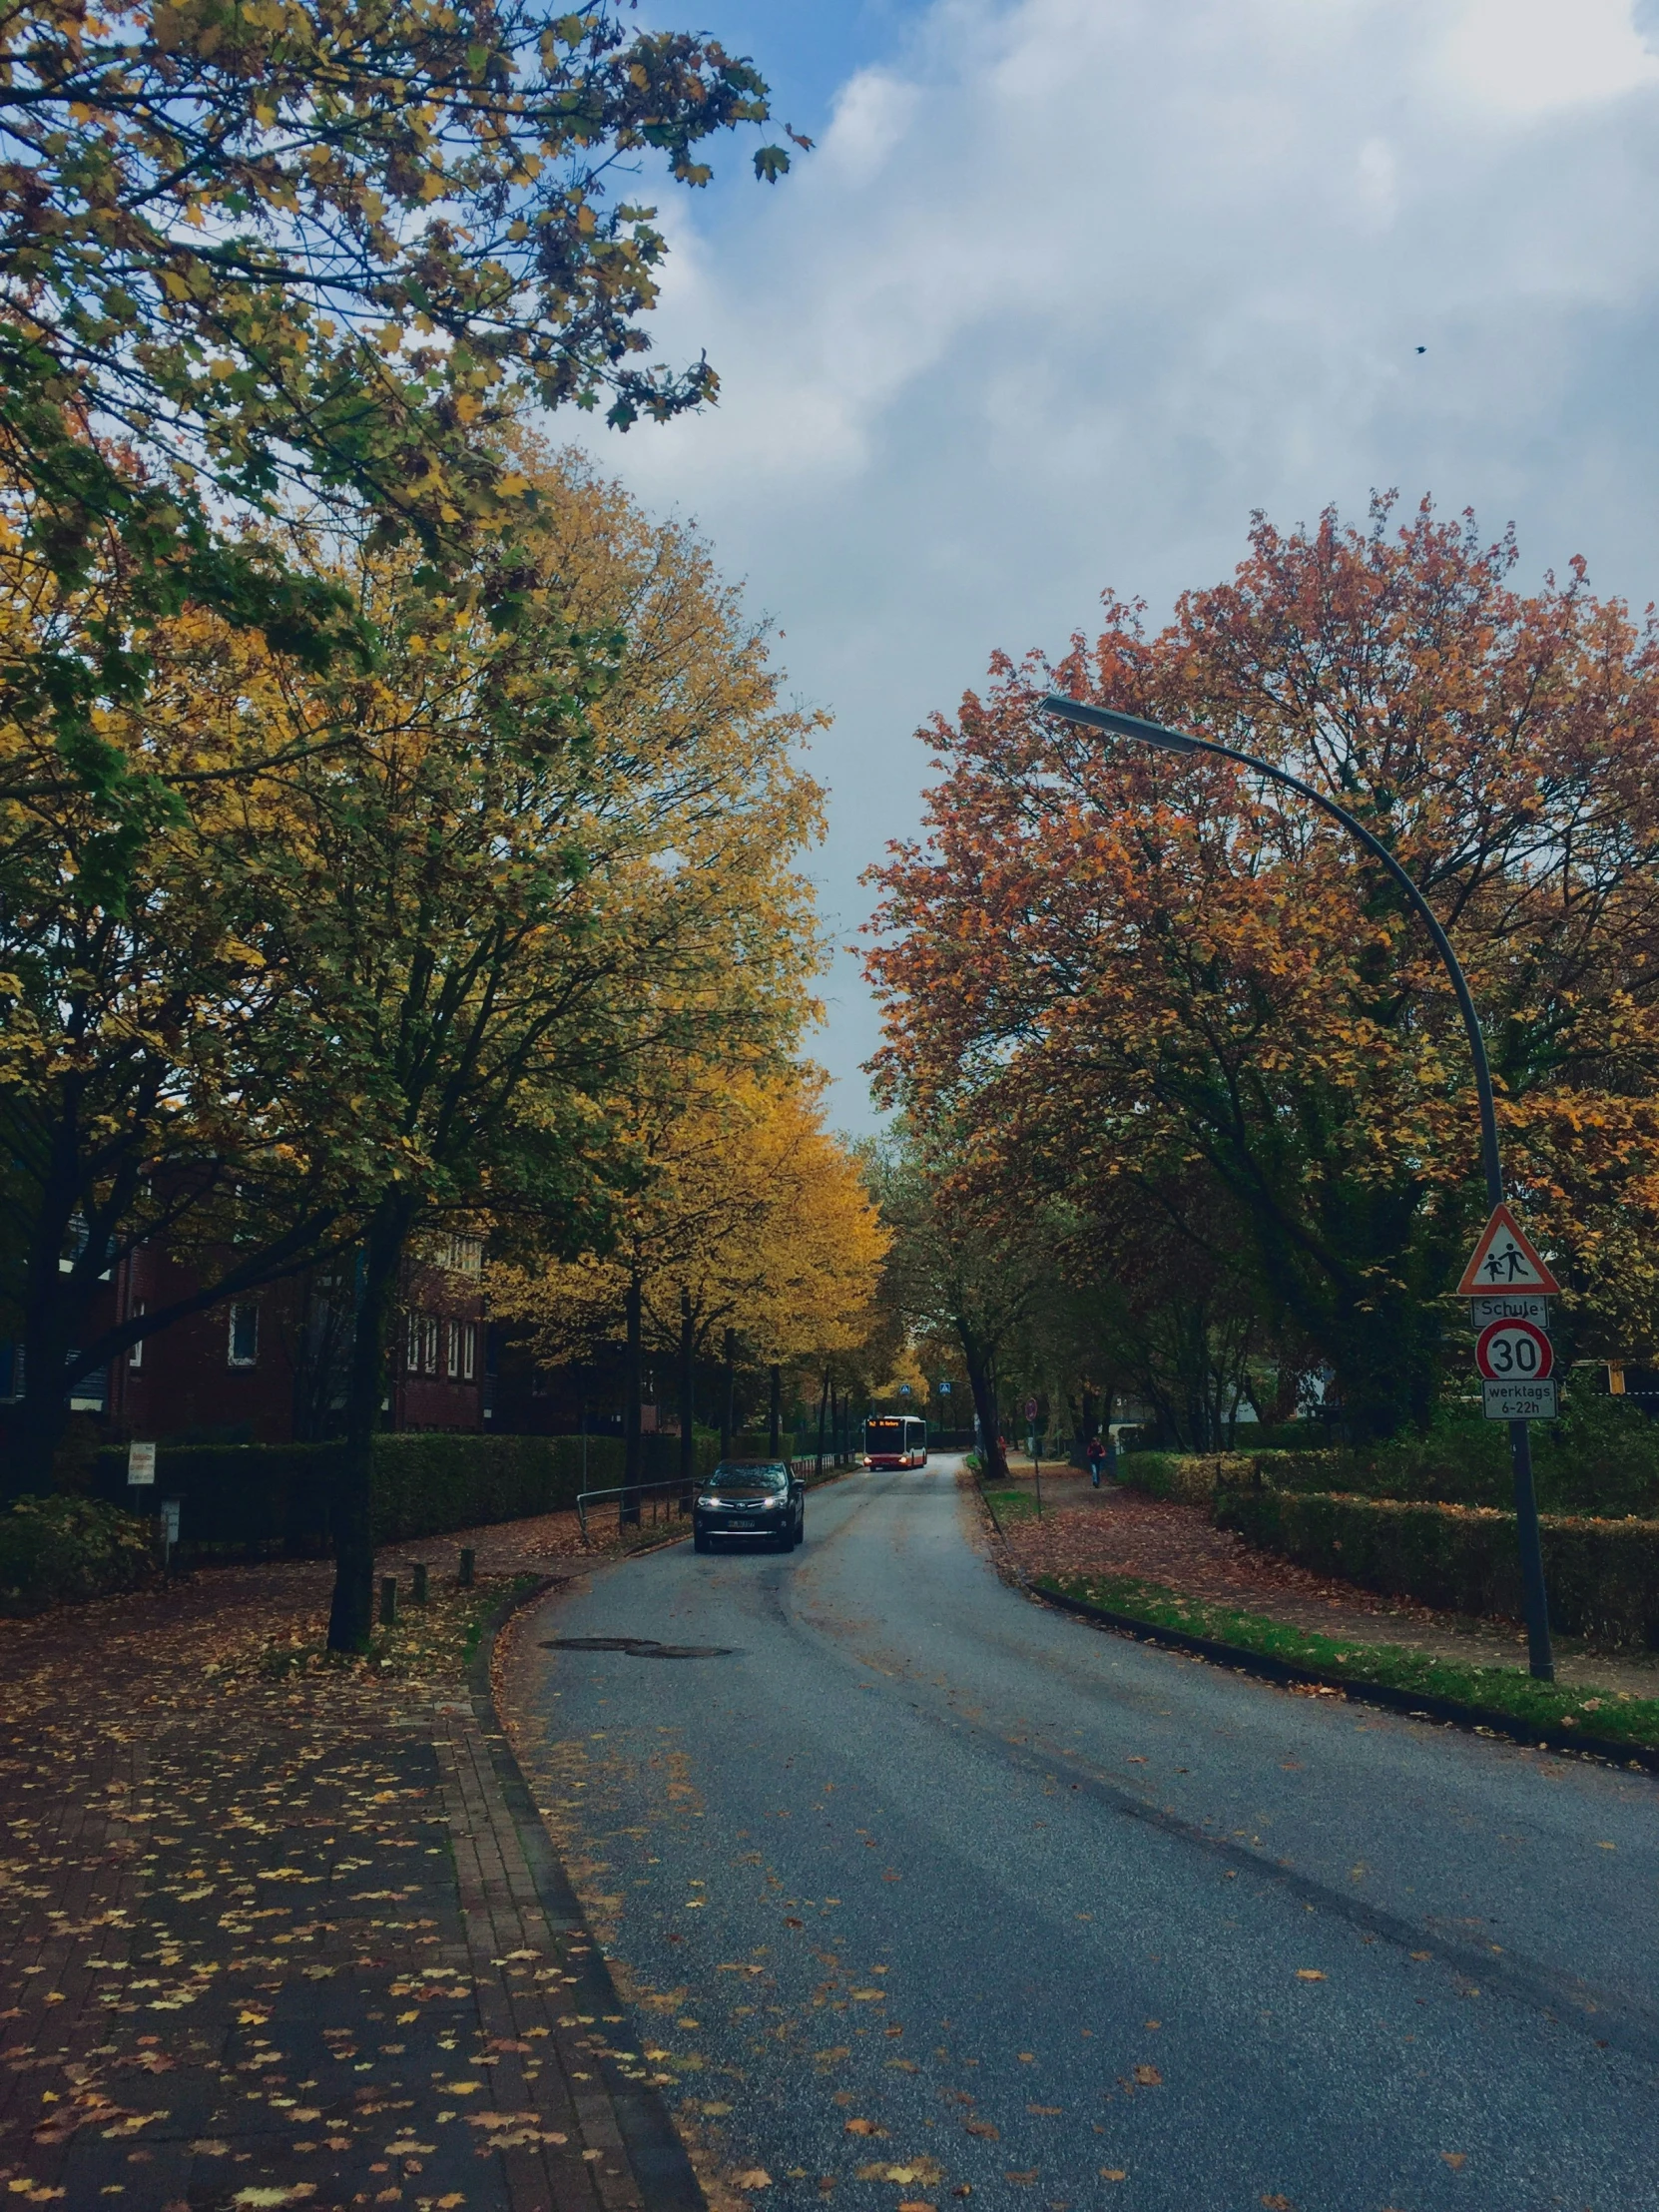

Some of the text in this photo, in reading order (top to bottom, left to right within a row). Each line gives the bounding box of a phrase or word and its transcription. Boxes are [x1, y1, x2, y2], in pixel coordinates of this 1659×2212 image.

[1481, 1301, 1538, 1316] Schule
[1492, 1339, 1536, 1372] 30
[1488, 1385, 1550, 1399] werktags
[1501, 1401, 1539, 1413] 6-22h
